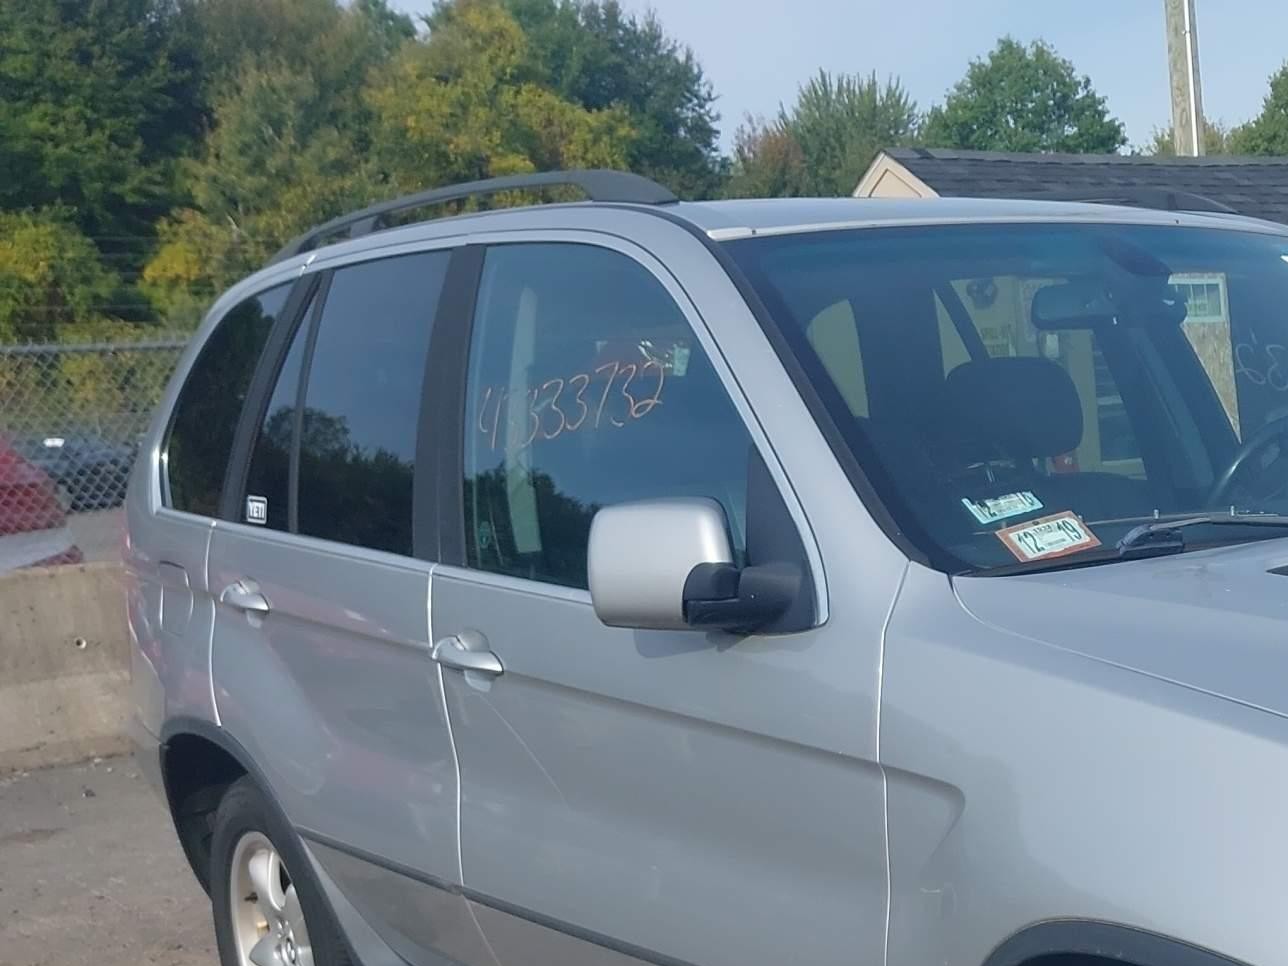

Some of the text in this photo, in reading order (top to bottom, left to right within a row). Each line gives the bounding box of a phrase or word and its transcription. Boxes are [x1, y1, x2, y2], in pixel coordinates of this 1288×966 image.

[479, 361, 664, 449] 4333732
[1017, 531, 1046, 555] 12
[1056, 520, 1082, 542] 19
